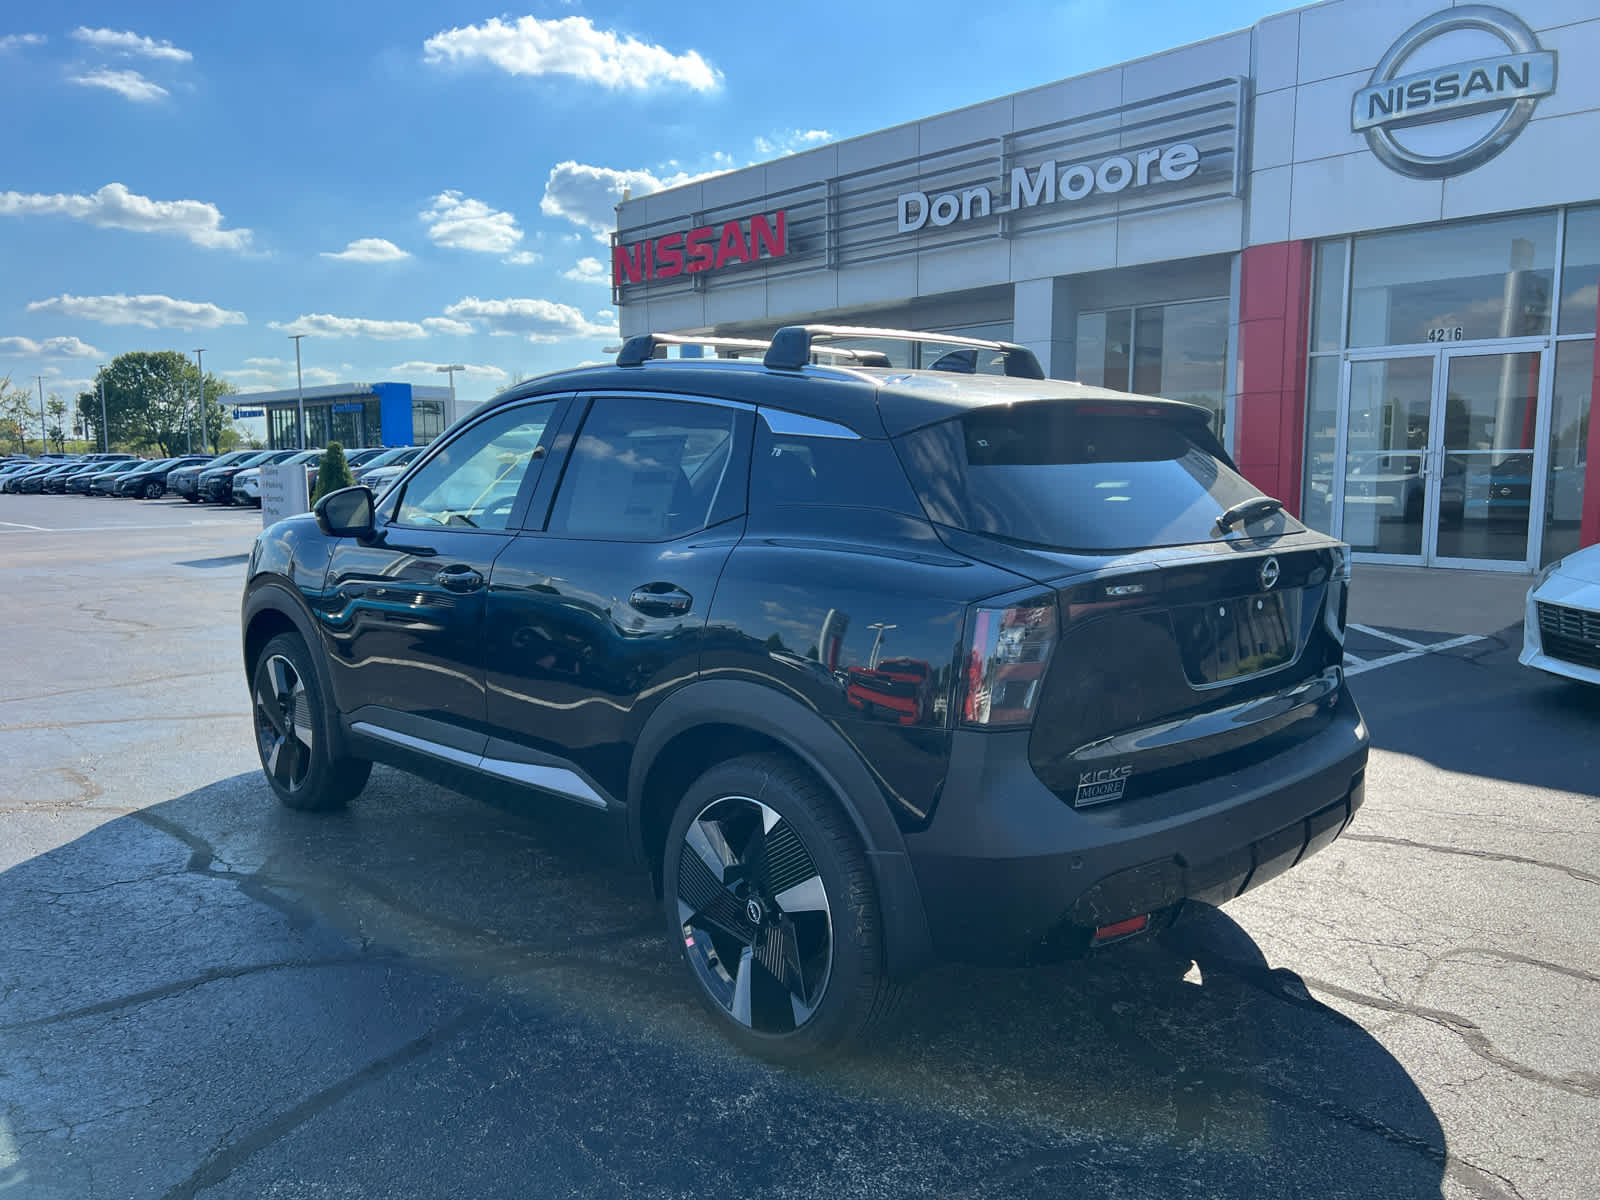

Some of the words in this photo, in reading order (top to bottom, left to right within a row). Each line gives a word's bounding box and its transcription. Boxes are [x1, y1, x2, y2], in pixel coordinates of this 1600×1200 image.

[1368, 61, 1529, 120] NISSAN
[897, 185, 992, 233] Don
[1010, 143, 1201, 210] Moore
[614, 210, 786, 286] NISSAN
[1079, 764, 1133, 784] KICKS
[1080, 781, 1121, 799] MOORE
